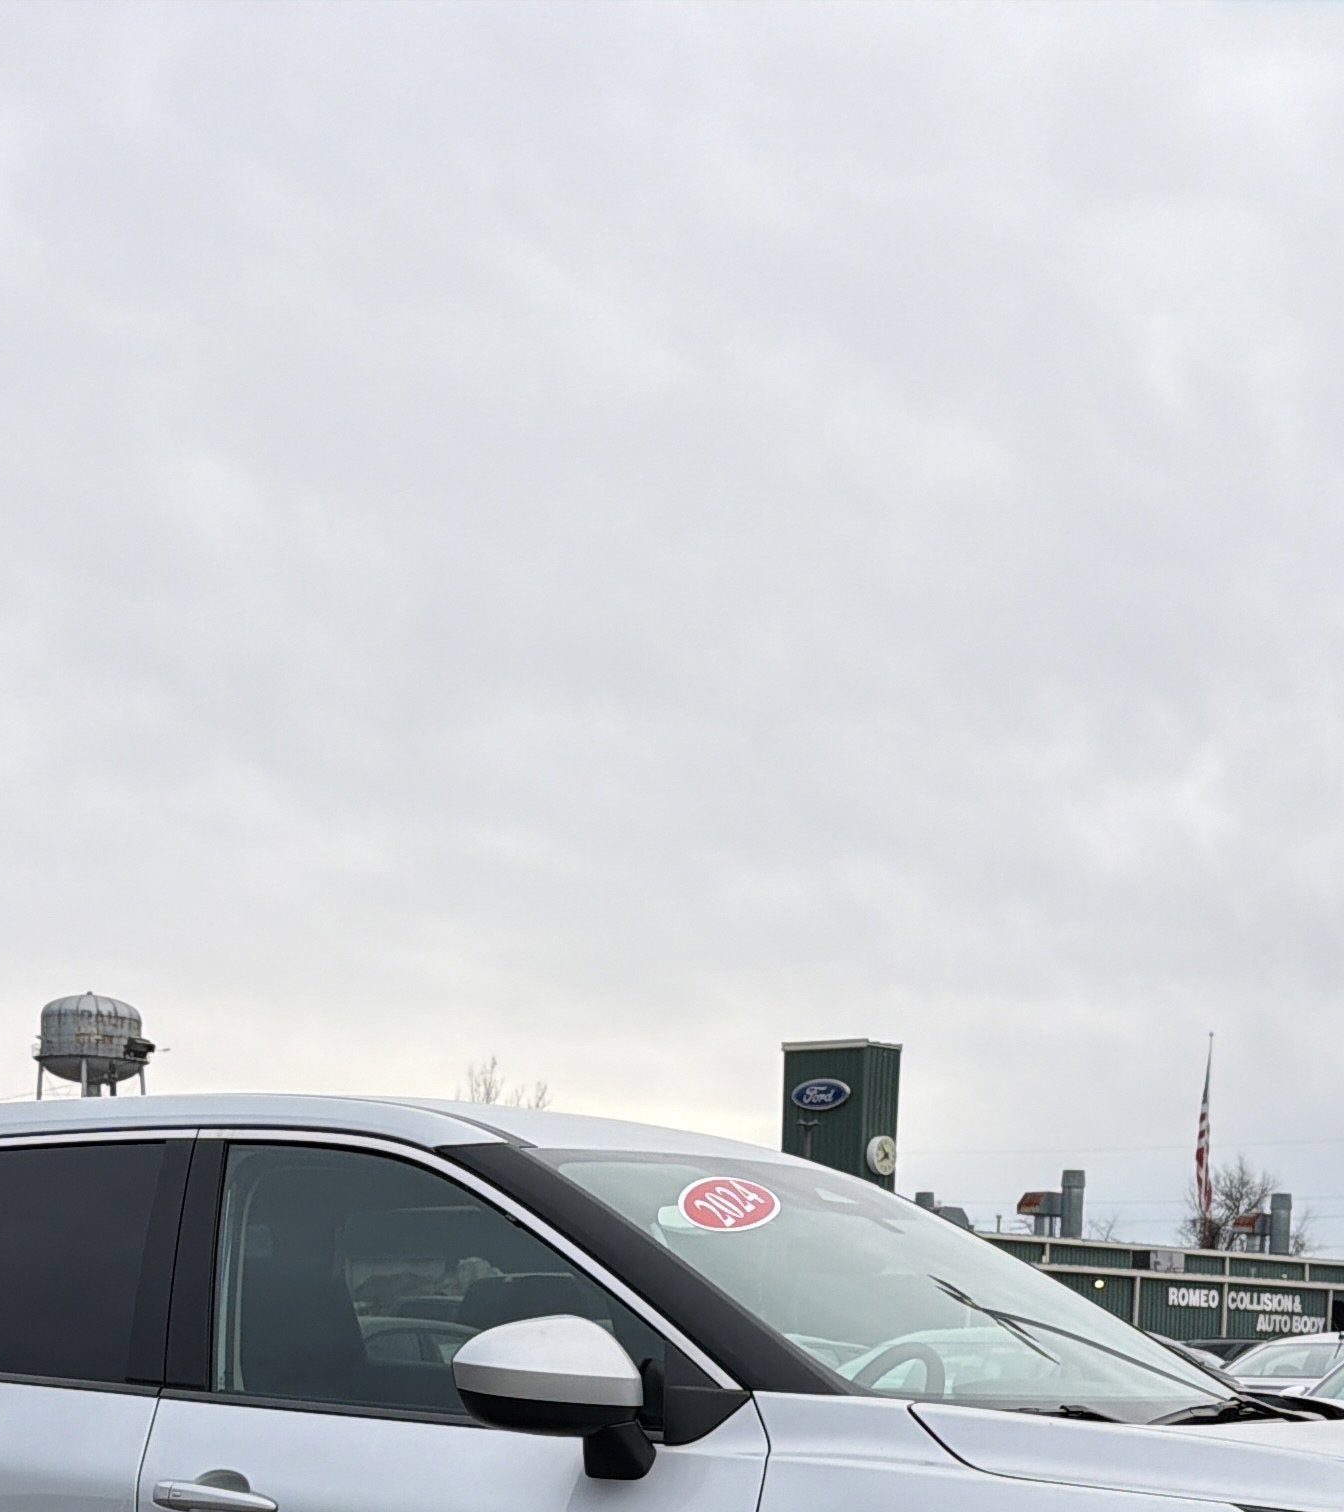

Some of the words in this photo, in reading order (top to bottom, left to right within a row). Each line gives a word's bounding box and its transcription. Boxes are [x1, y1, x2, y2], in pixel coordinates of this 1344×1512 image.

[803, 1086, 834, 1103] Ford
[694, 1180, 765, 1227] 2024
[1168, 1287, 1219, 1309] ROMEO
[1228, 1291, 1293, 1312] COLLISION
[1256, 1314, 1291, 1333] AUTO
[1292, 1316, 1325, 1333] BODY
